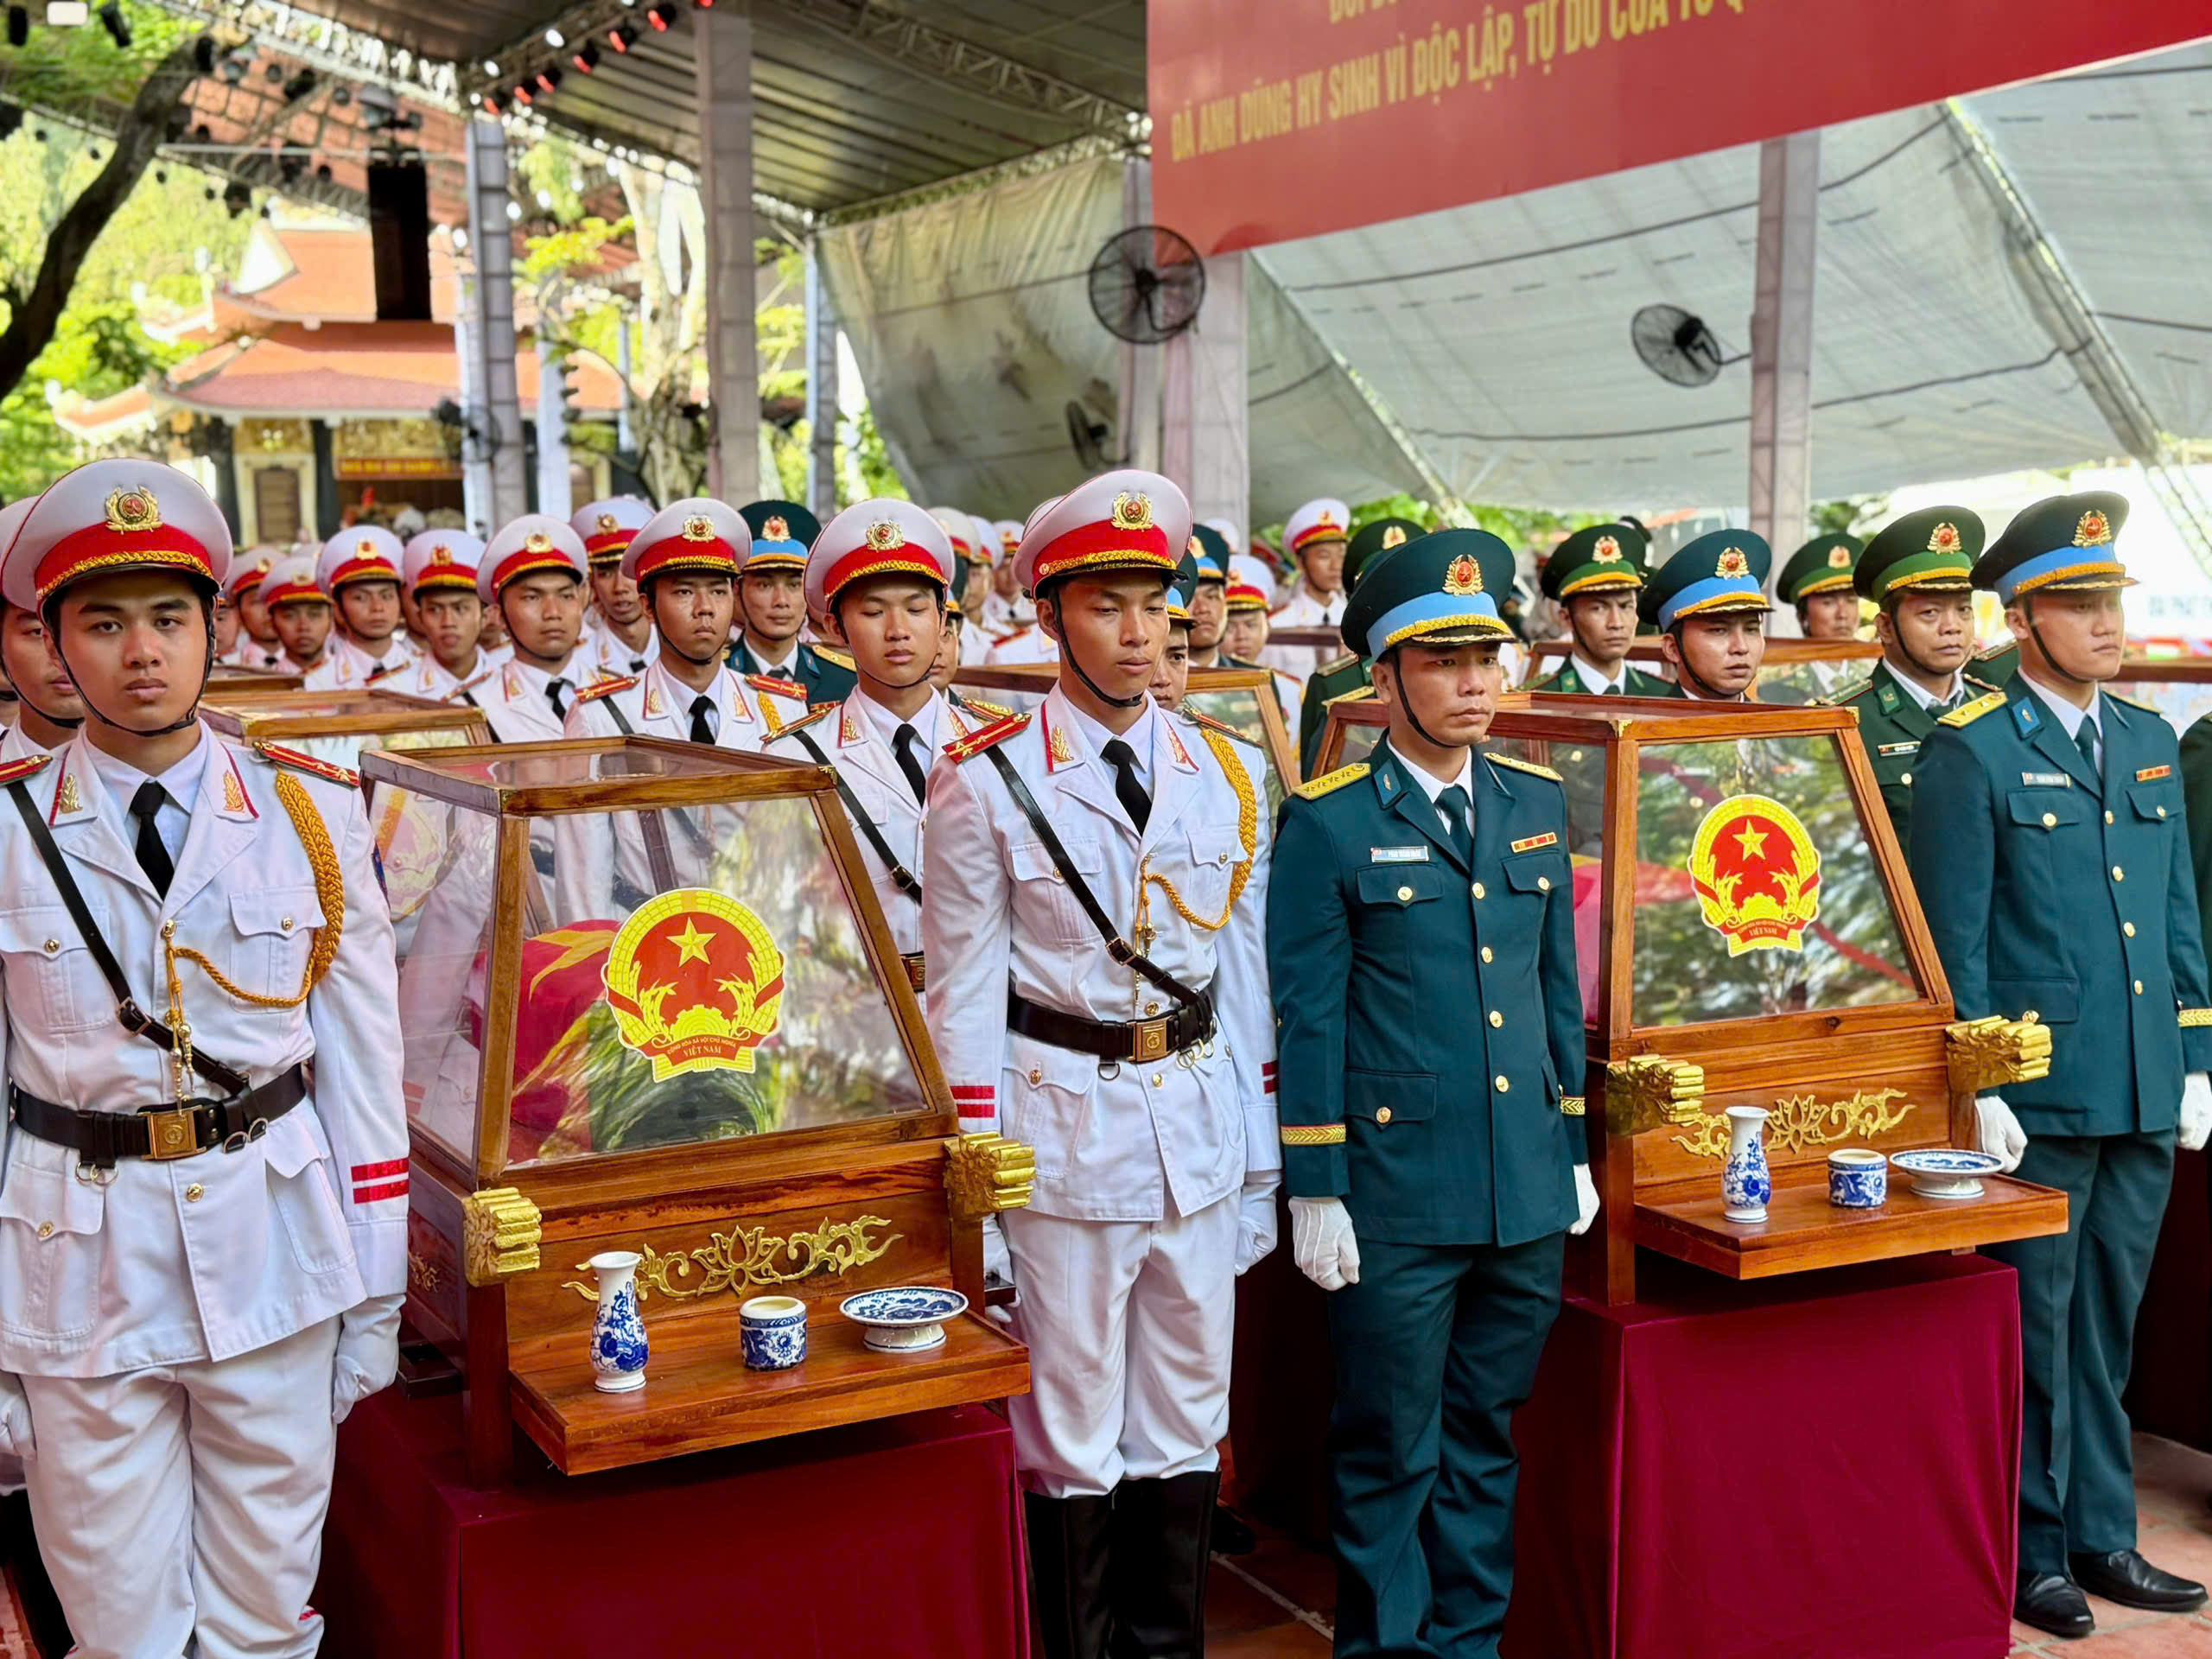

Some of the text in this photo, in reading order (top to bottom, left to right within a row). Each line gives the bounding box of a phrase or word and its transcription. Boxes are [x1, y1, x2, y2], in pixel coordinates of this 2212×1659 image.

[1198, 97, 1236, 155] ANH
[1296, 70, 1324, 130] HY
[1329, 54, 1380, 120] SINH
[1384, 31, 1408, 104] VÌ
[1412, 21, 1461, 105] ĐỘC
[1467, 4, 1517, 92] LẬP,
[683, 1045, 721, 1057] VIỆT NAM
